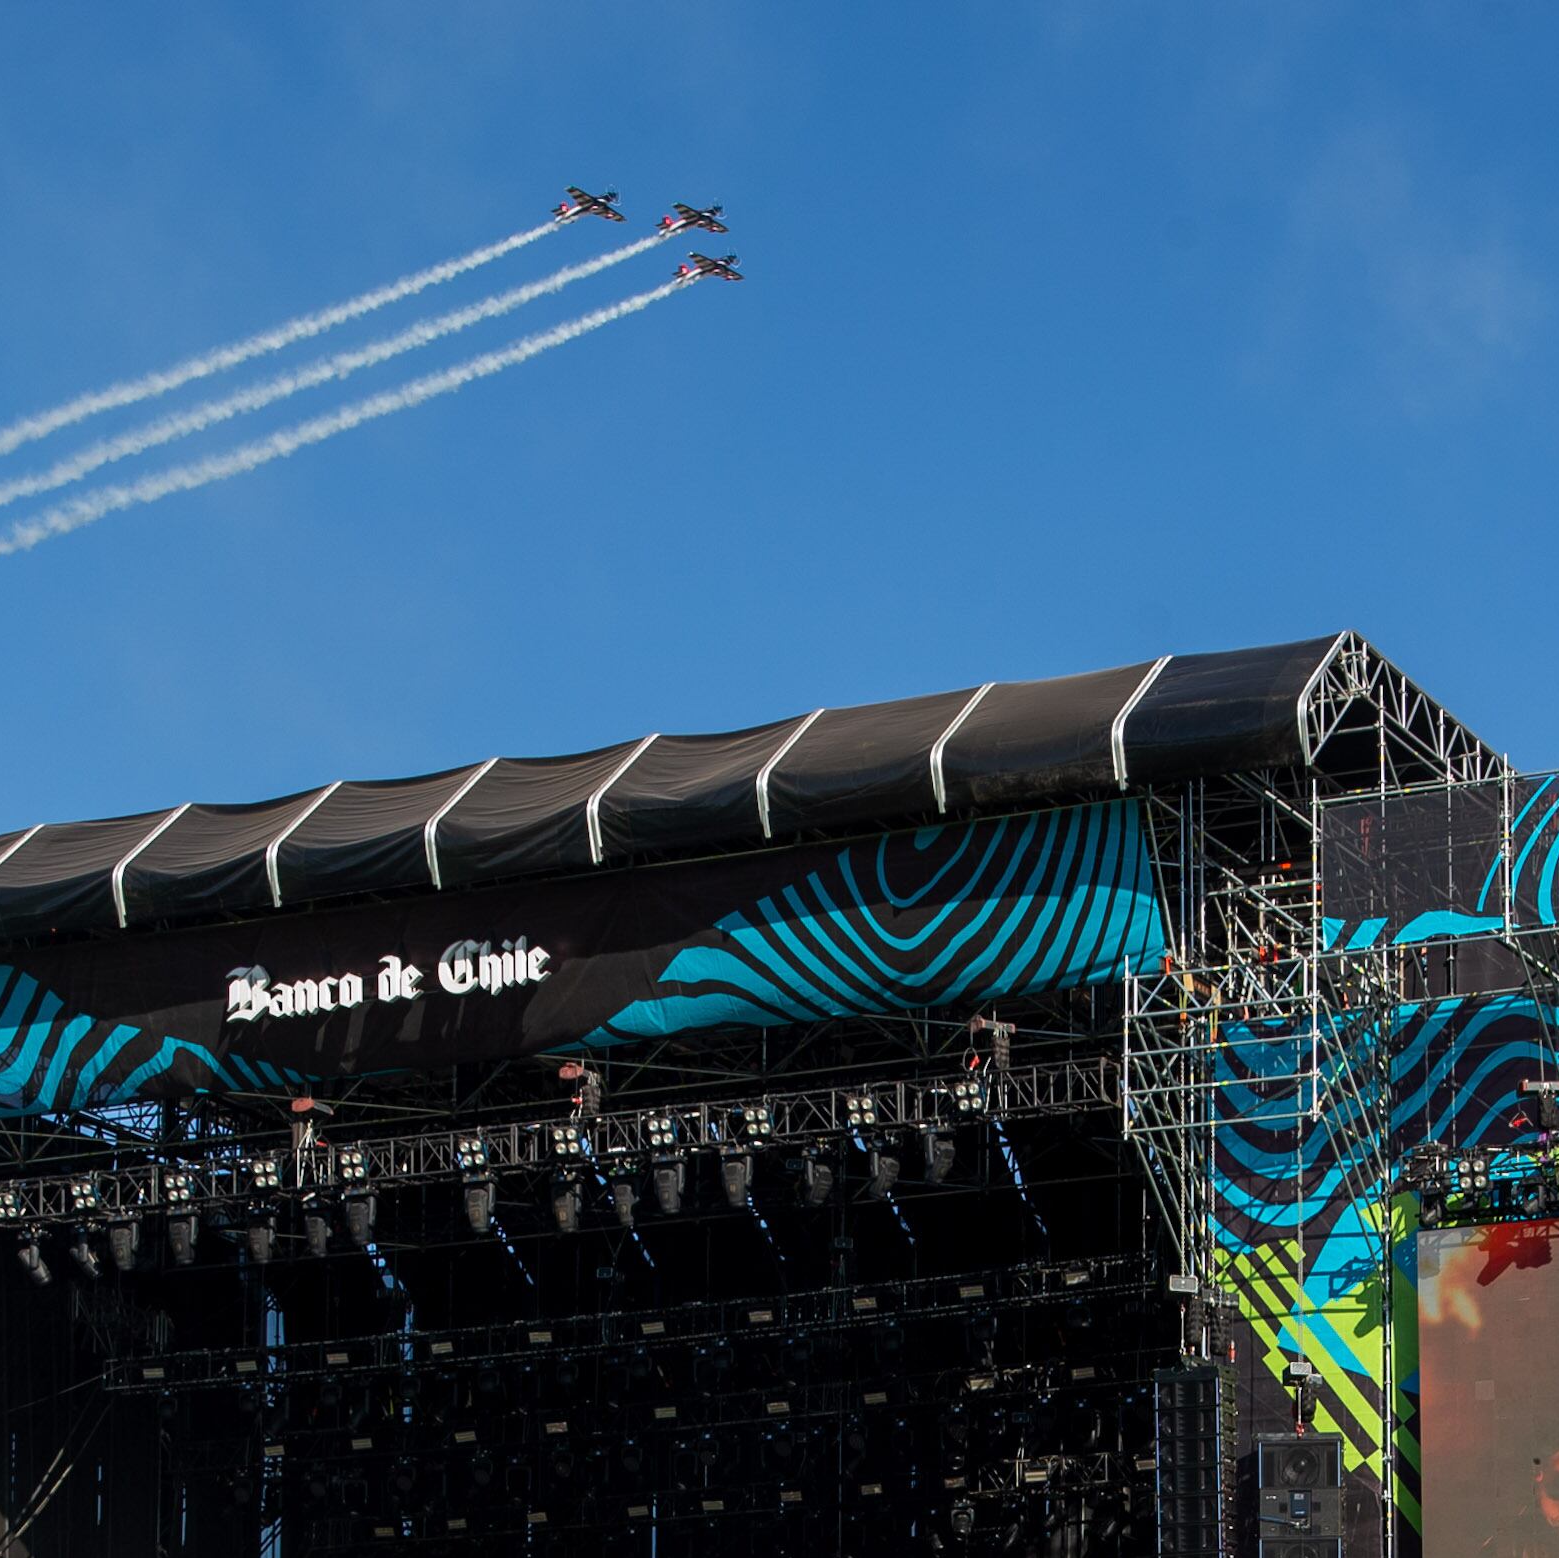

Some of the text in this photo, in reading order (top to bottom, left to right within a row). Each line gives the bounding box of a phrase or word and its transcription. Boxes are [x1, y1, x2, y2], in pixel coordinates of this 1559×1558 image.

[226, 935, 551, 1022] Banco de Chile
